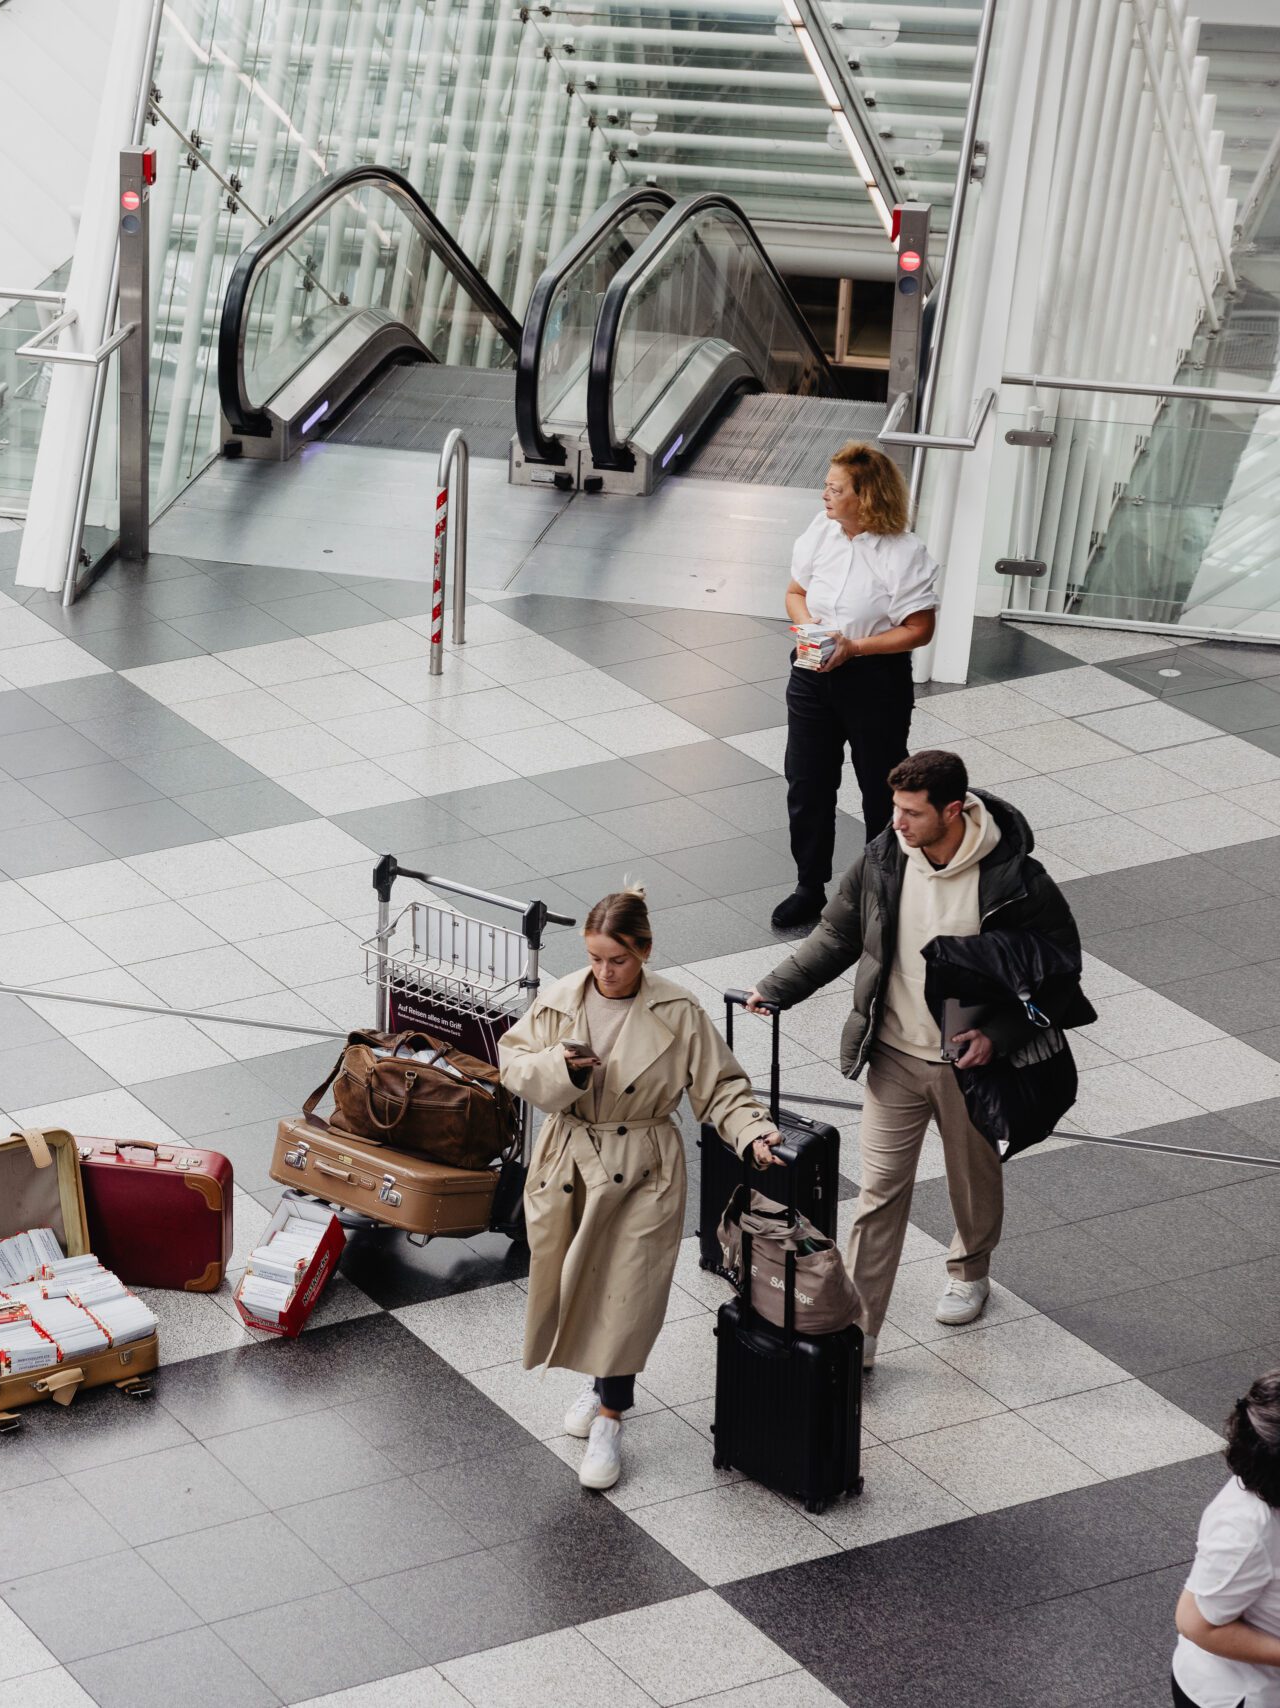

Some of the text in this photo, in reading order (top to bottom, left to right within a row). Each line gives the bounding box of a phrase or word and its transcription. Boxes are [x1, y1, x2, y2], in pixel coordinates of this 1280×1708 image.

[398, 1003, 408, 1012] Auf
[409, 1006, 427, 1019] Reisen
[427, 1014, 441, 1024] alles
[441, 1017, 449, 1026] im
